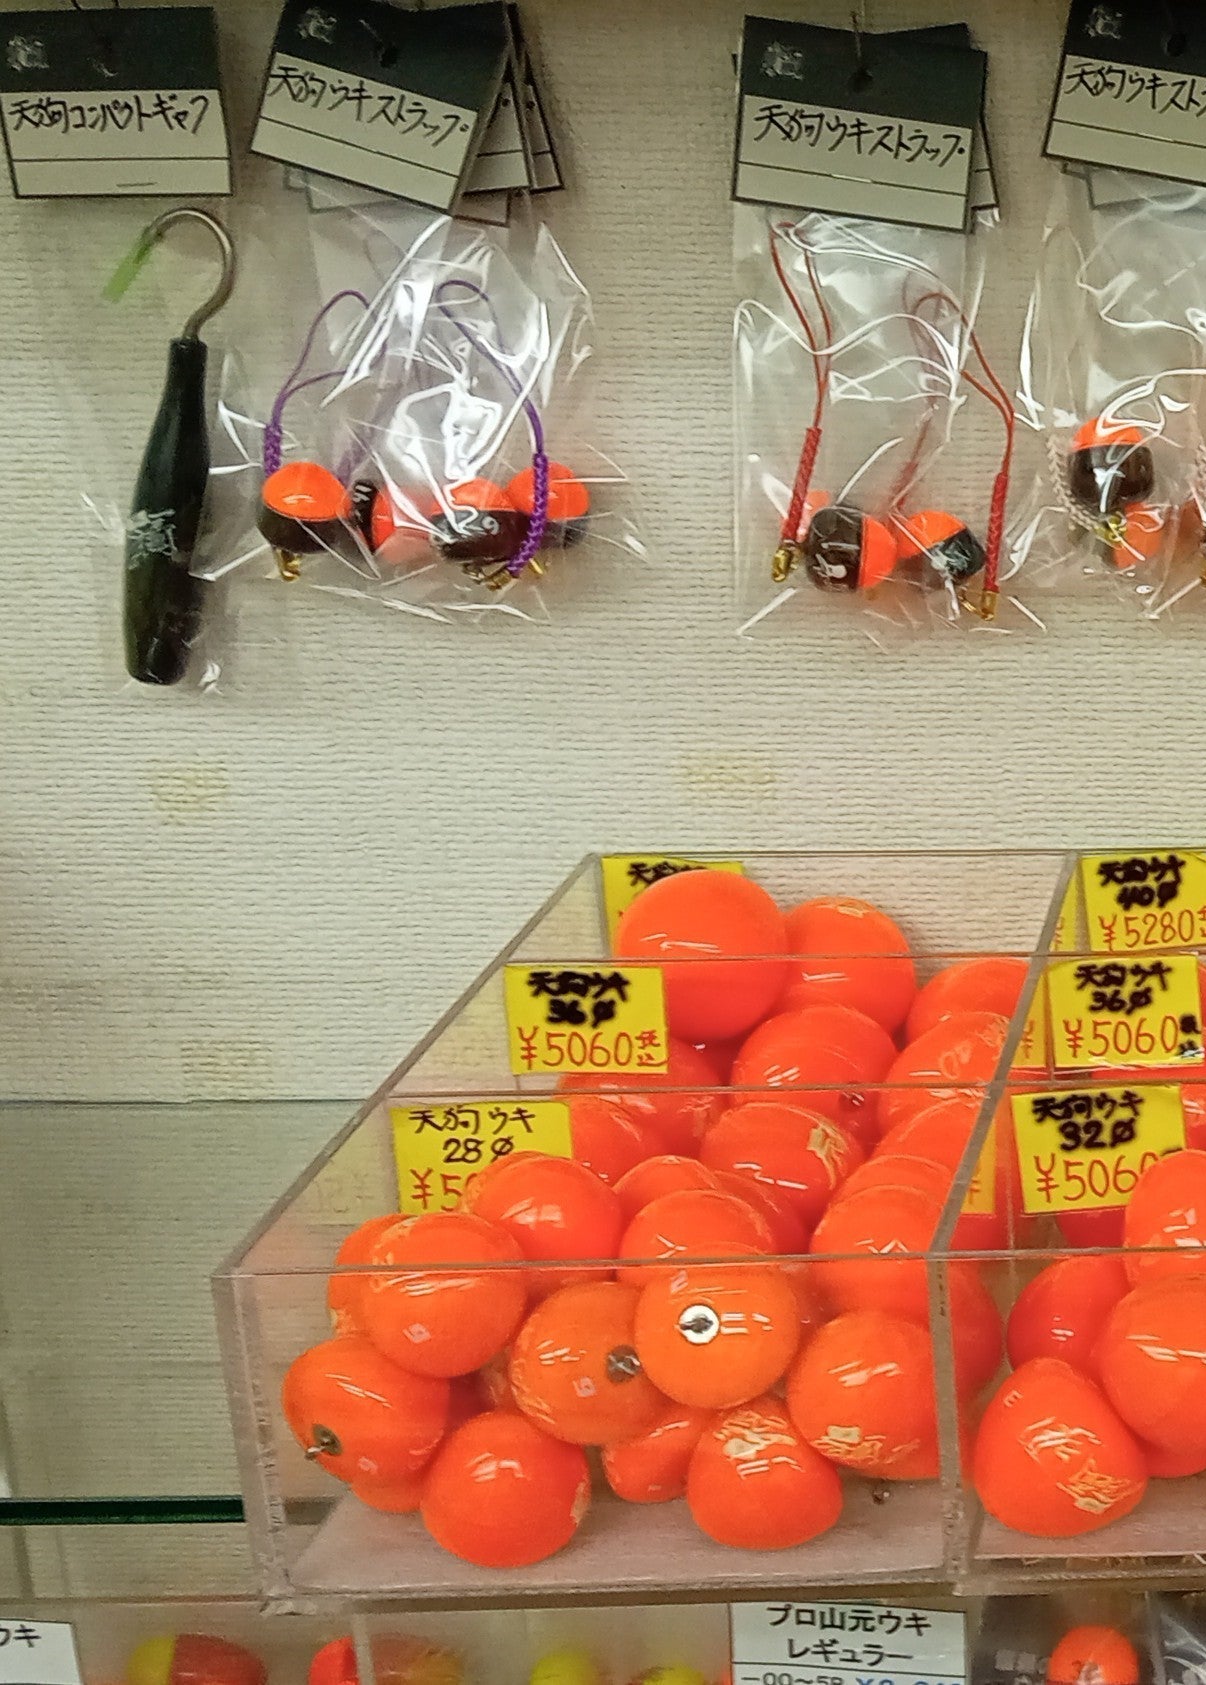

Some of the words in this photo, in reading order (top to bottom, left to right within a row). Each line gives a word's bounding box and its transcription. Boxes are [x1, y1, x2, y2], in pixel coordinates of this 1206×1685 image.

[408, 1104, 536, 1135] 天狗ウキ
[766, 1603, 932, 1637] プロ山元ウキ
[788, 1638, 914, 1667] レギュラー
